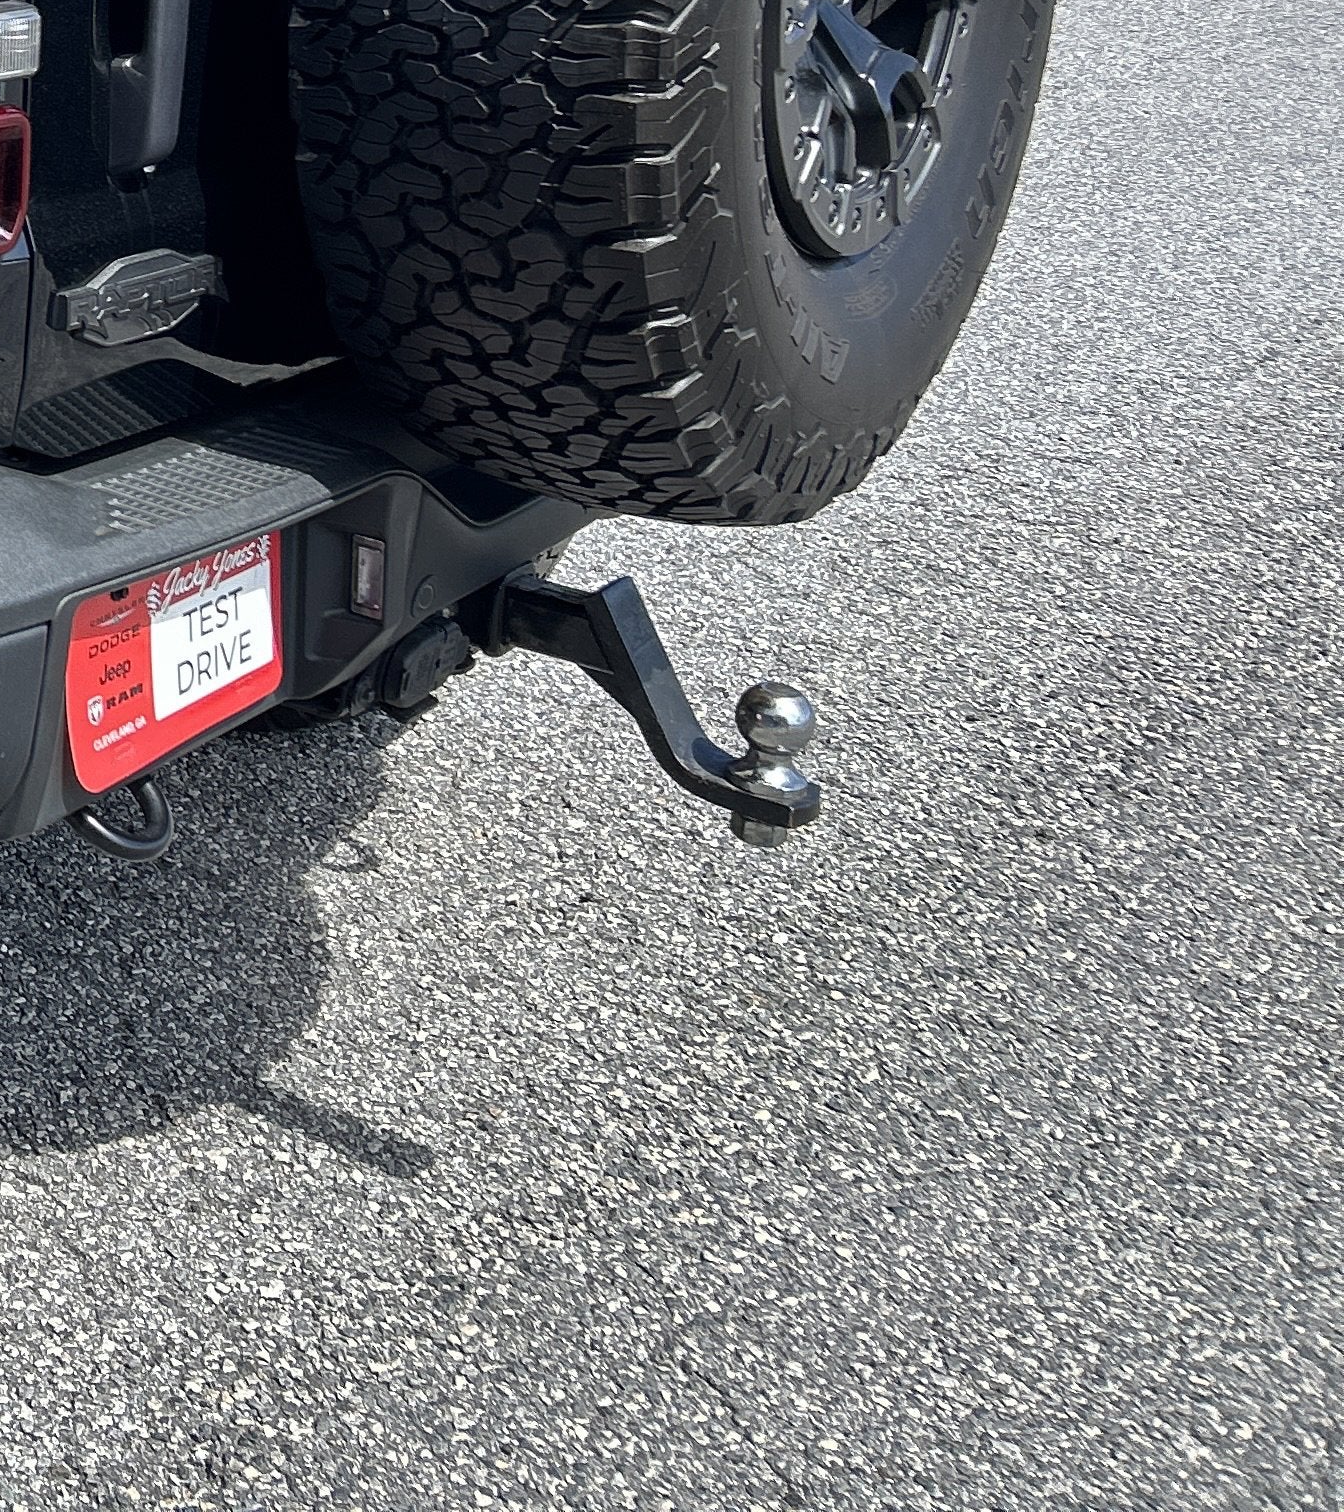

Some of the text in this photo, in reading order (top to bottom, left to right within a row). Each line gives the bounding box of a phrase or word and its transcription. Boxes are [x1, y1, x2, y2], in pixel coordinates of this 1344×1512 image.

[182, 586, 244, 642] TEST
[88, 624, 141, 659] DODGE
[98, 658, 132, 686] Jeep
[176, 629, 252, 696] DRIVE
[106, 682, 144, 709] RAM
